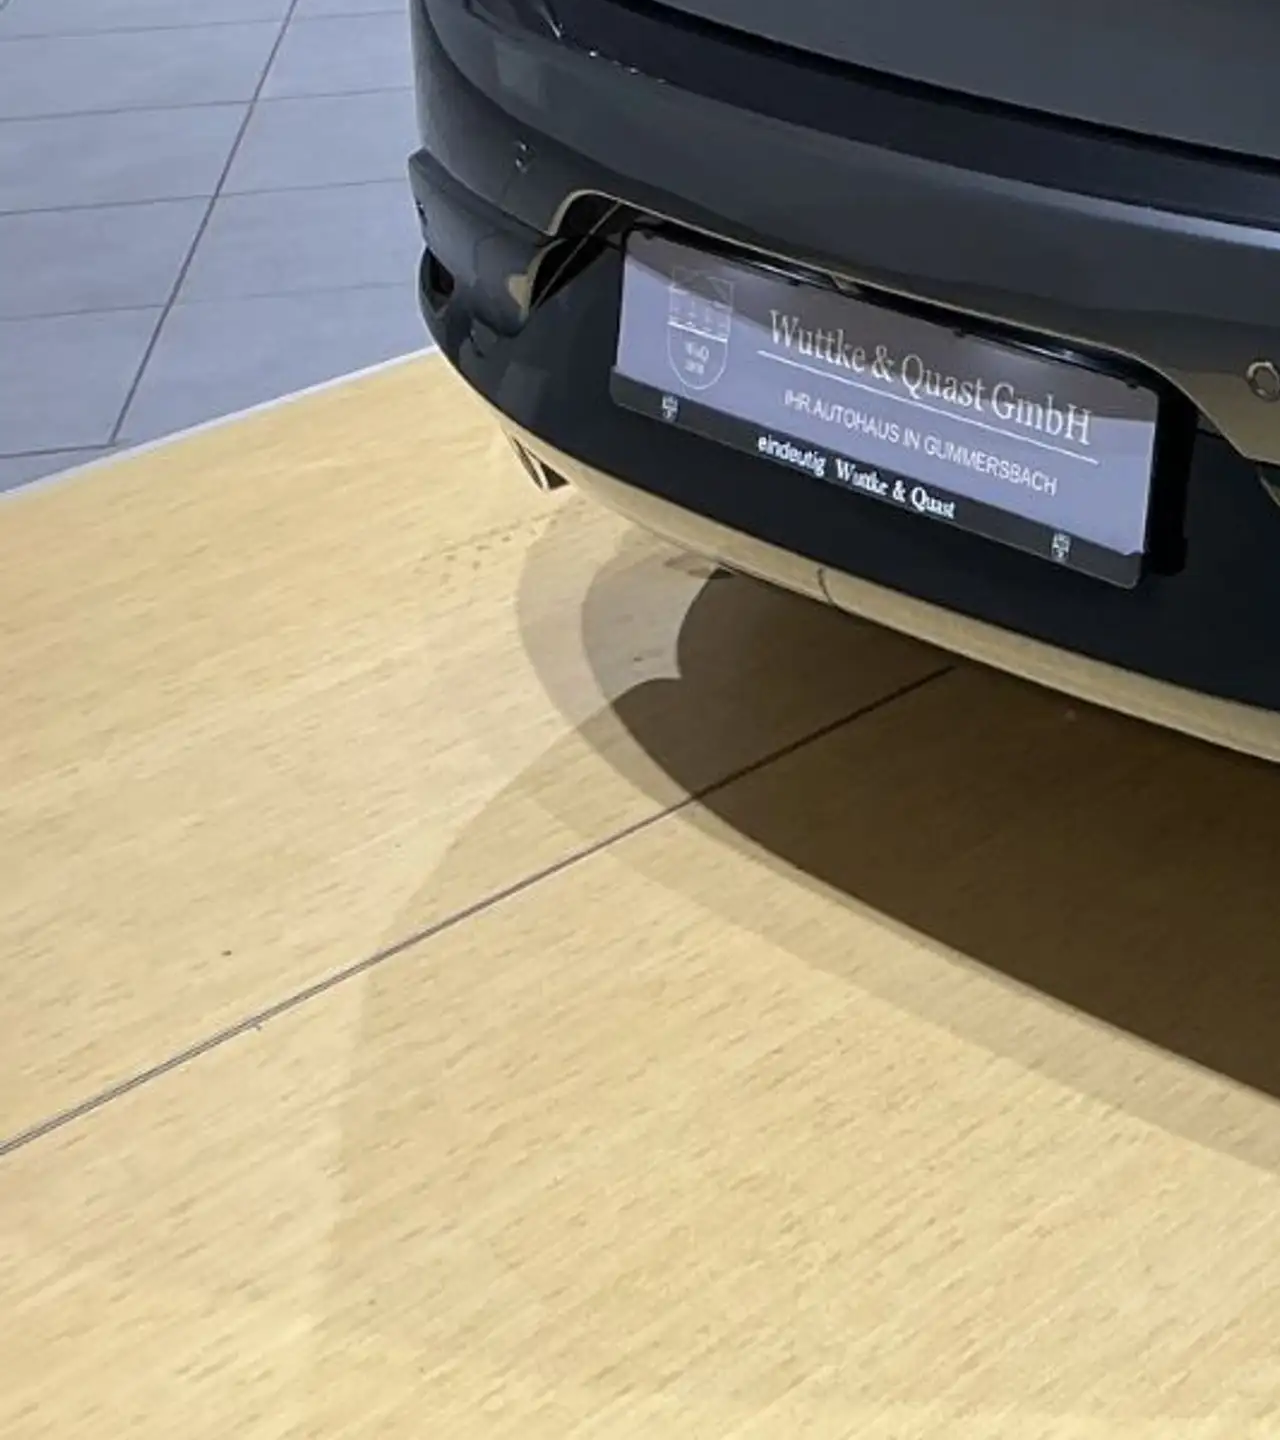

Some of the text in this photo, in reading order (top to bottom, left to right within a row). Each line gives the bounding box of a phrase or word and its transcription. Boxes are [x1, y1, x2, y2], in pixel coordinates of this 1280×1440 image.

[770, 309, 1092, 446] Wuttke & Quast GmbH
[758, 434, 955, 520] eindeutig Wuttke & Quast
[784, 388, 1059, 497] IHR AUTOHAUS IN GUMMERSBACH
